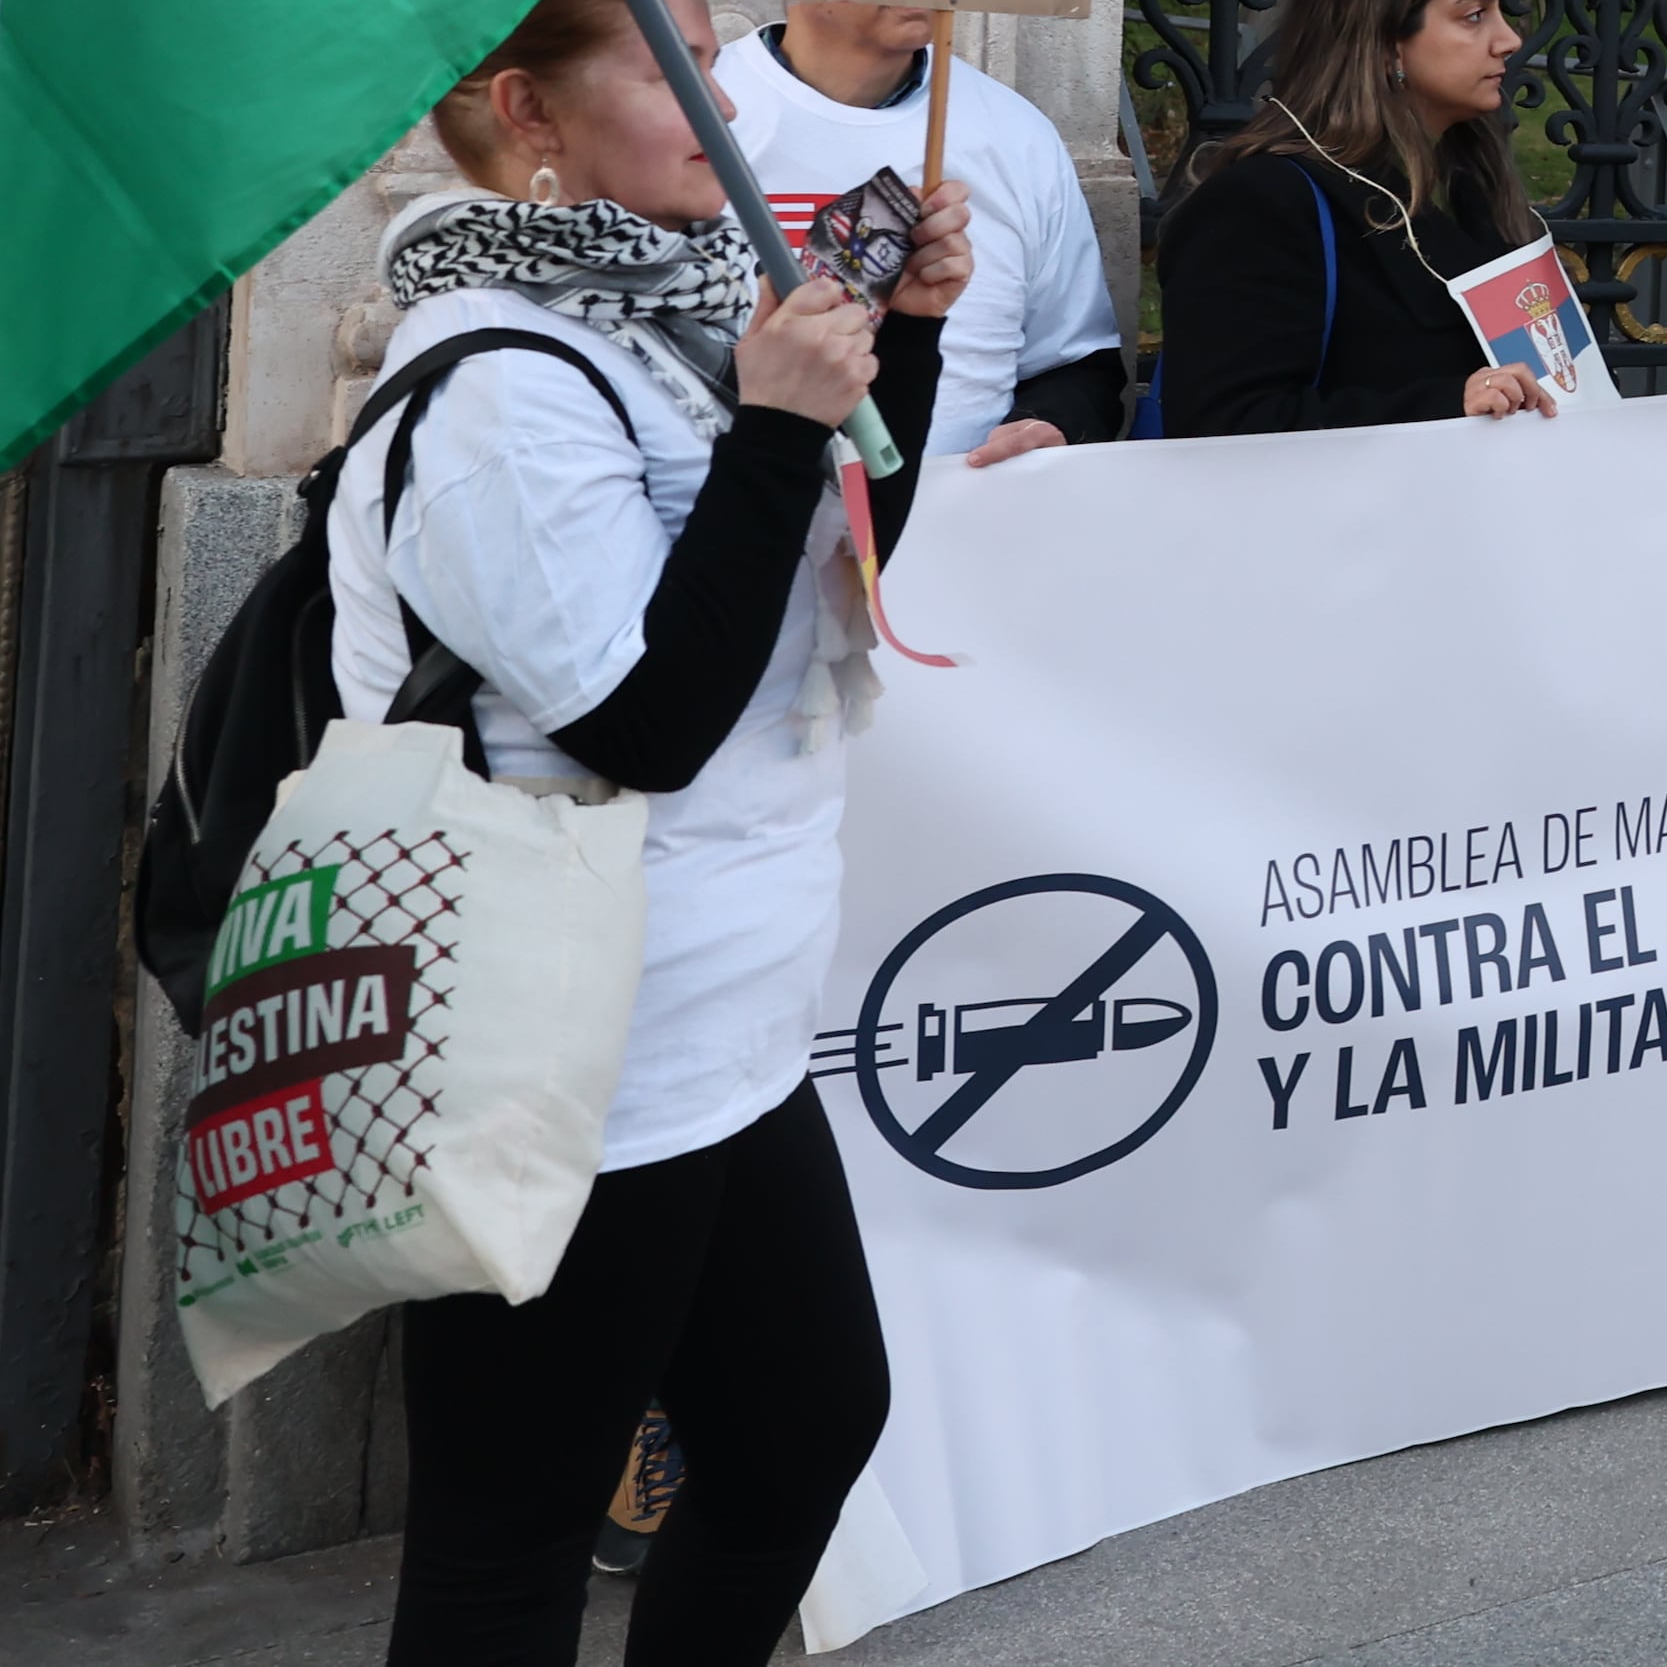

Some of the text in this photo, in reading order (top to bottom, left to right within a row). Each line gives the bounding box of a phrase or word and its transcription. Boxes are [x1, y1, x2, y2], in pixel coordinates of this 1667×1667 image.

[1260, 821, 1524, 927] ASAMBLEA
[1543, 806, 1597, 874] DE
[1261, 902, 1566, 1032] CONTRA
[1582, 885, 1657, 974] EL
[1257, 1052, 1312, 1130] Y
[1334, 1037, 1427, 1121] LA
[195, 1095, 320, 1199] LIBRE
